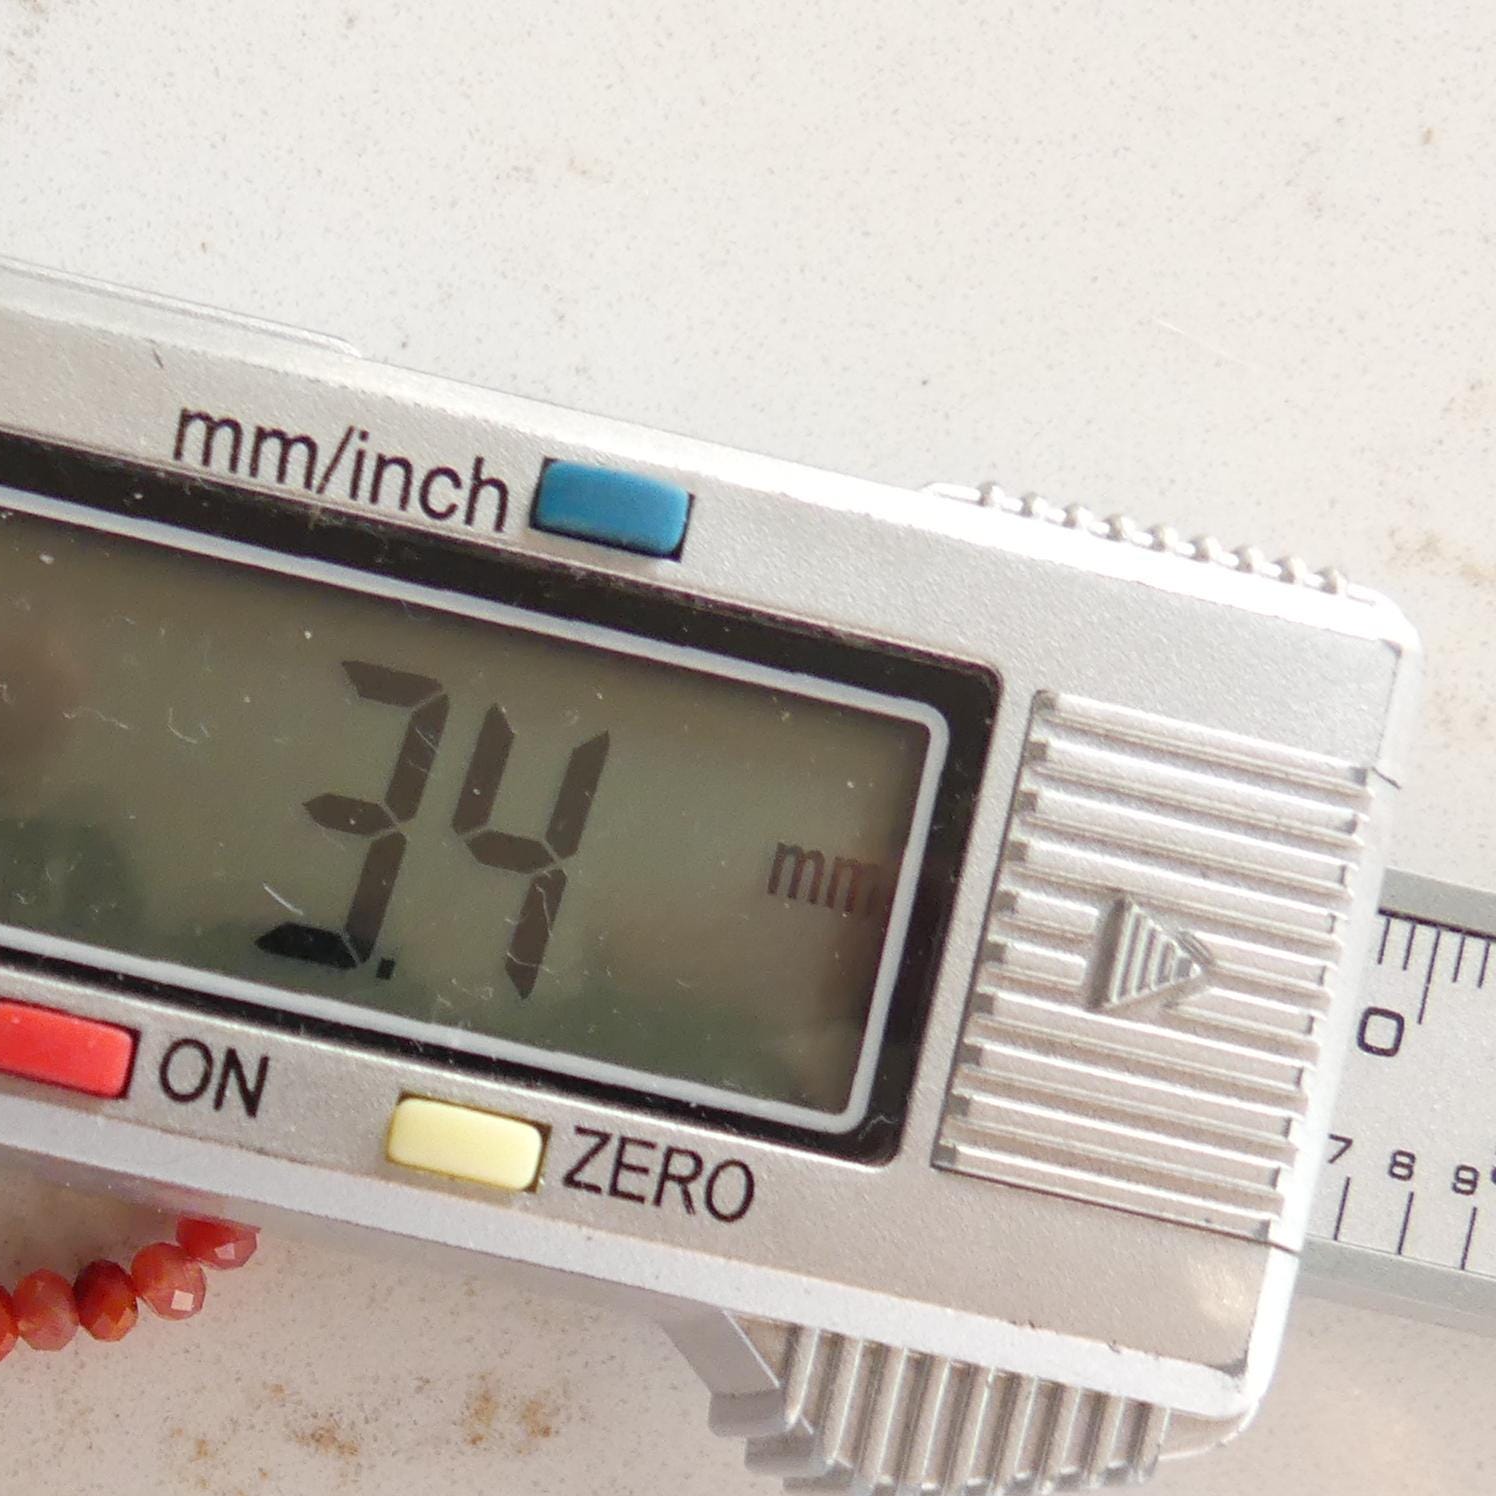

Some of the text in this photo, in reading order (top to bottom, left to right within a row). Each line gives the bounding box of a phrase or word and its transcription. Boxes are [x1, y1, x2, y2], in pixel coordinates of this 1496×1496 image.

[172, 406, 510, 533] mm/inch
[254, 660, 881, 1000] 3.4 mm
[159, 1038, 271, 1118] ON
[561, 1124, 756, 1223] ZERO
[1327, 1133, 1354, 1165] 7
[1387, 1149, 1417, 1182] 8
[1450, 1164, 1481, 1197] 9
